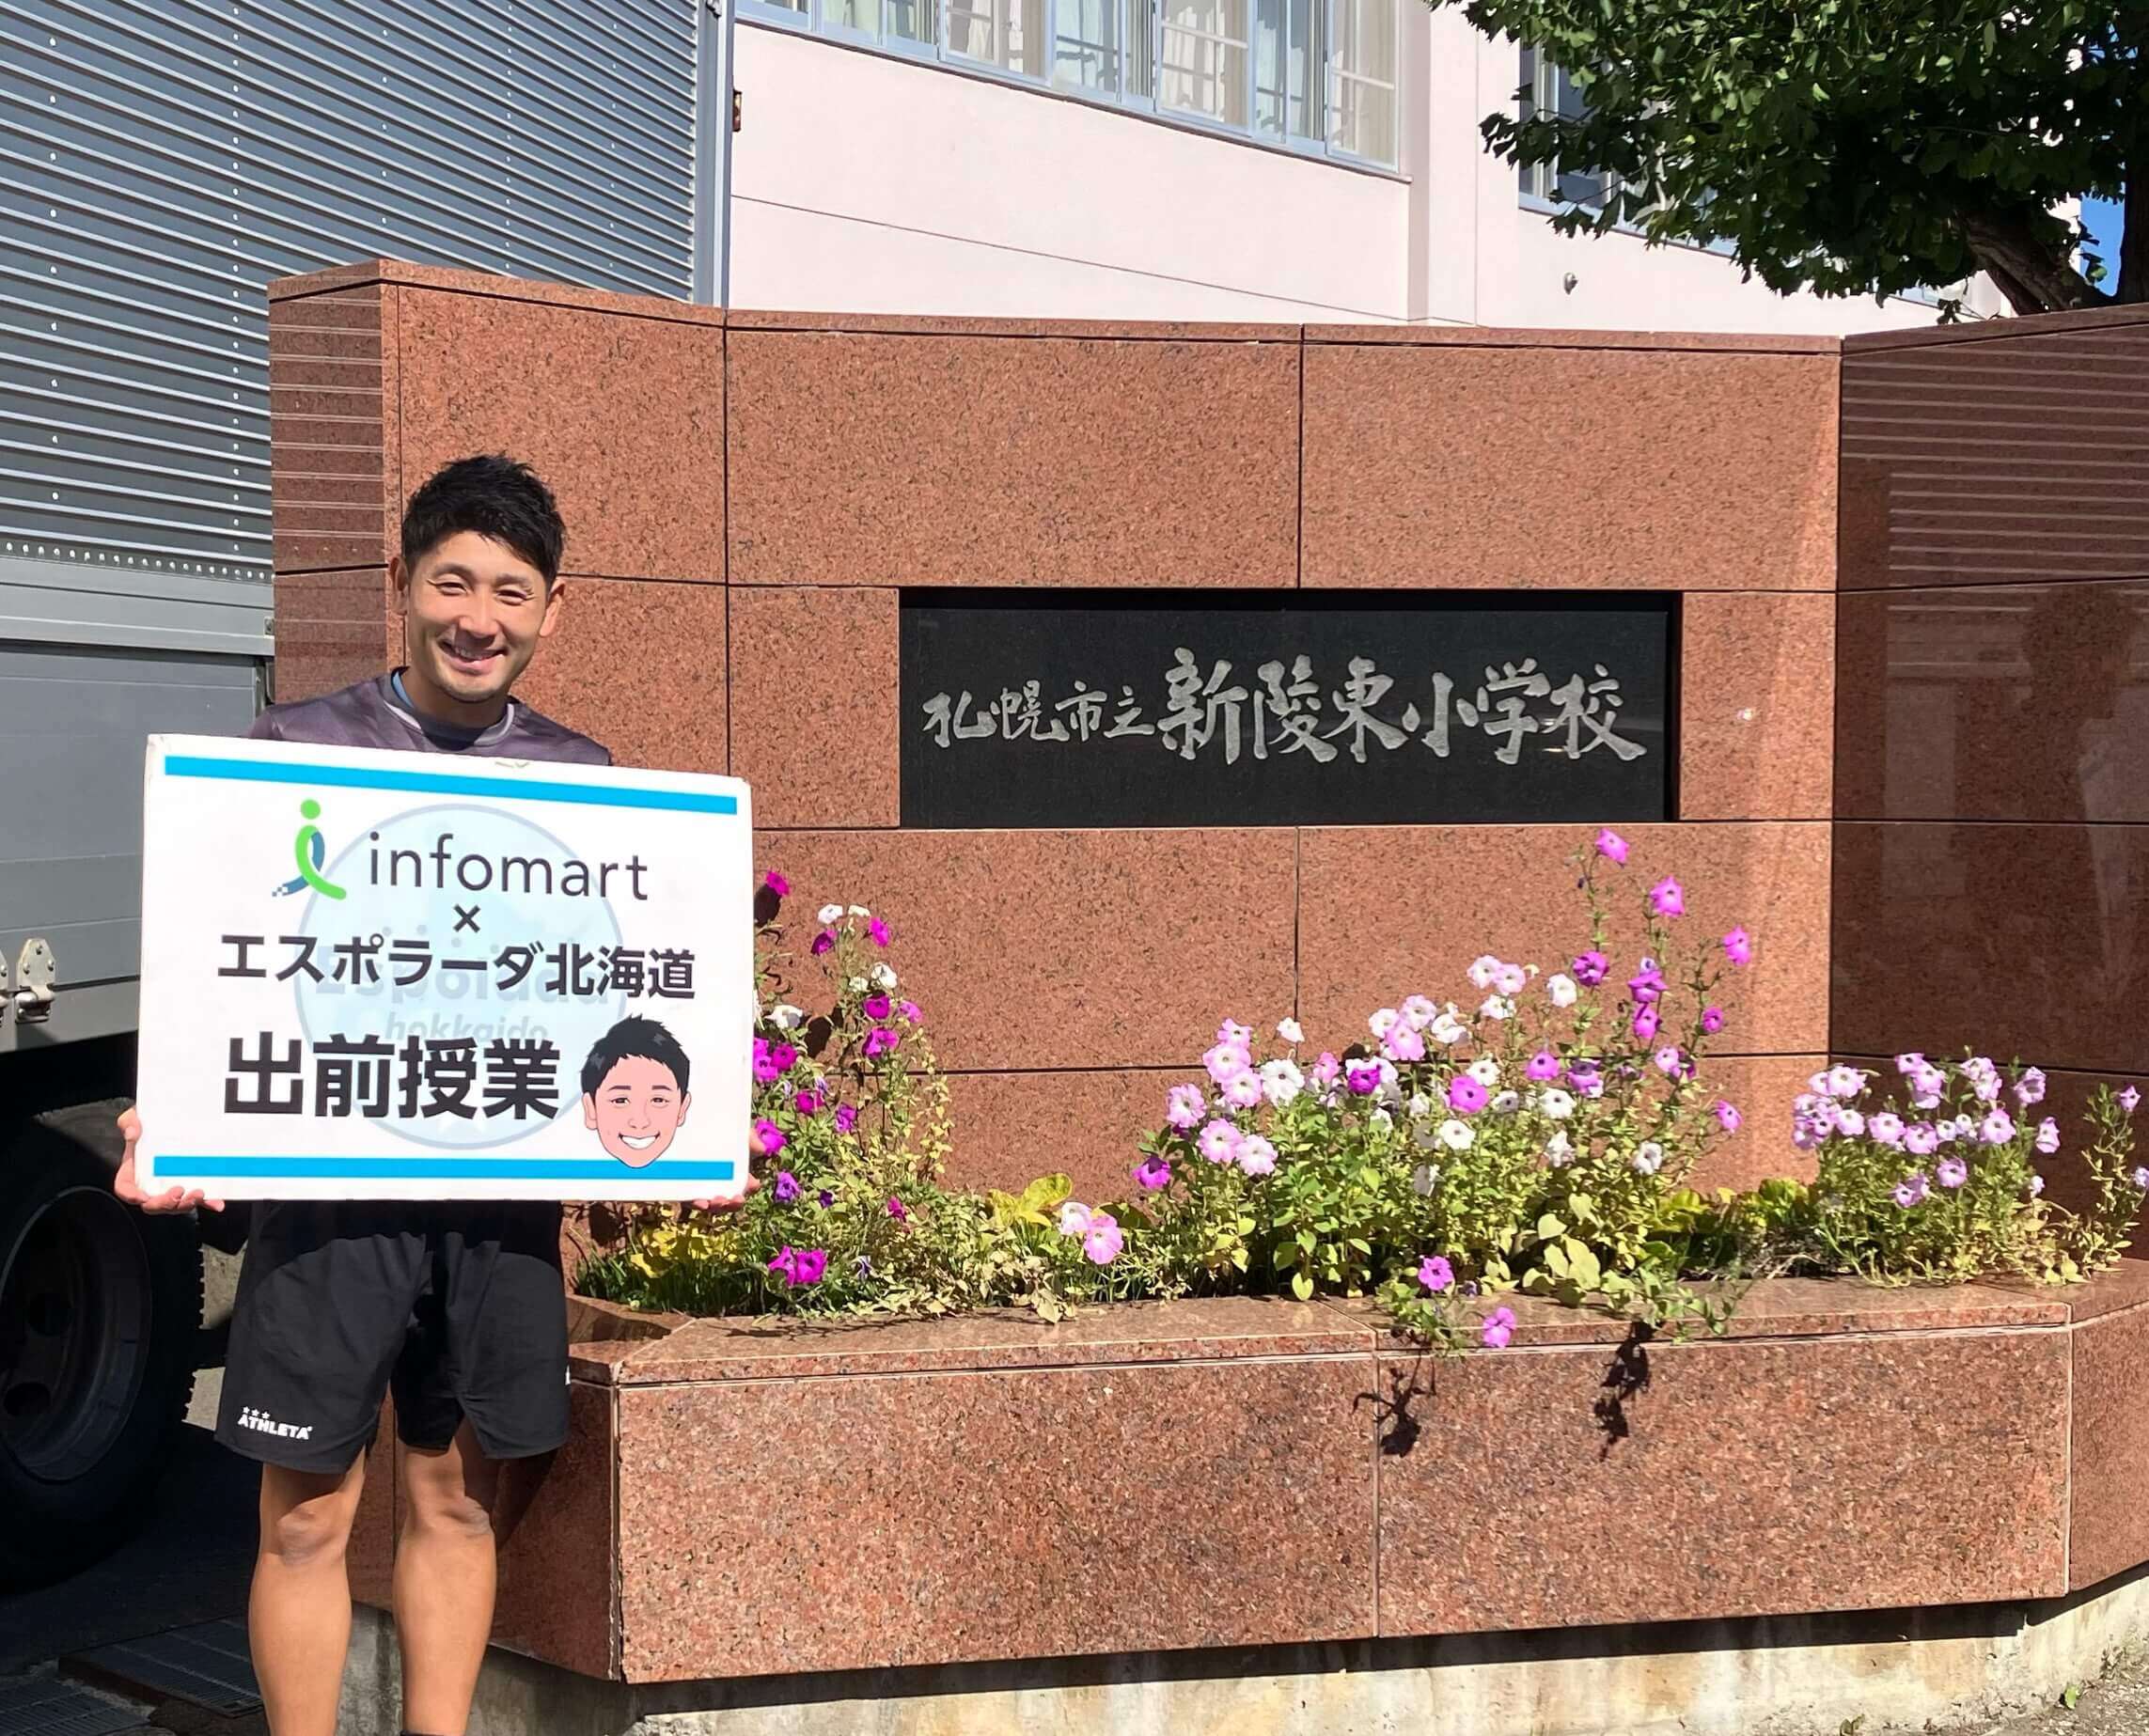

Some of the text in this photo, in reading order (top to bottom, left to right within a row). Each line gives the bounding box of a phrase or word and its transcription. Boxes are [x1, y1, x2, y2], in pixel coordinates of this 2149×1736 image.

[922, 647, 1647, 765] 札幌市立新陵東小学校
[369, 831, 649, 900] infomart
[217, 933, 696, 1000] エスポラーダ北海道
[315, 946, 610, 1005] Espol
[224, 1031, 561, 1119] 出前授業
[237, 1414, 310, 1440] ATHLETA
